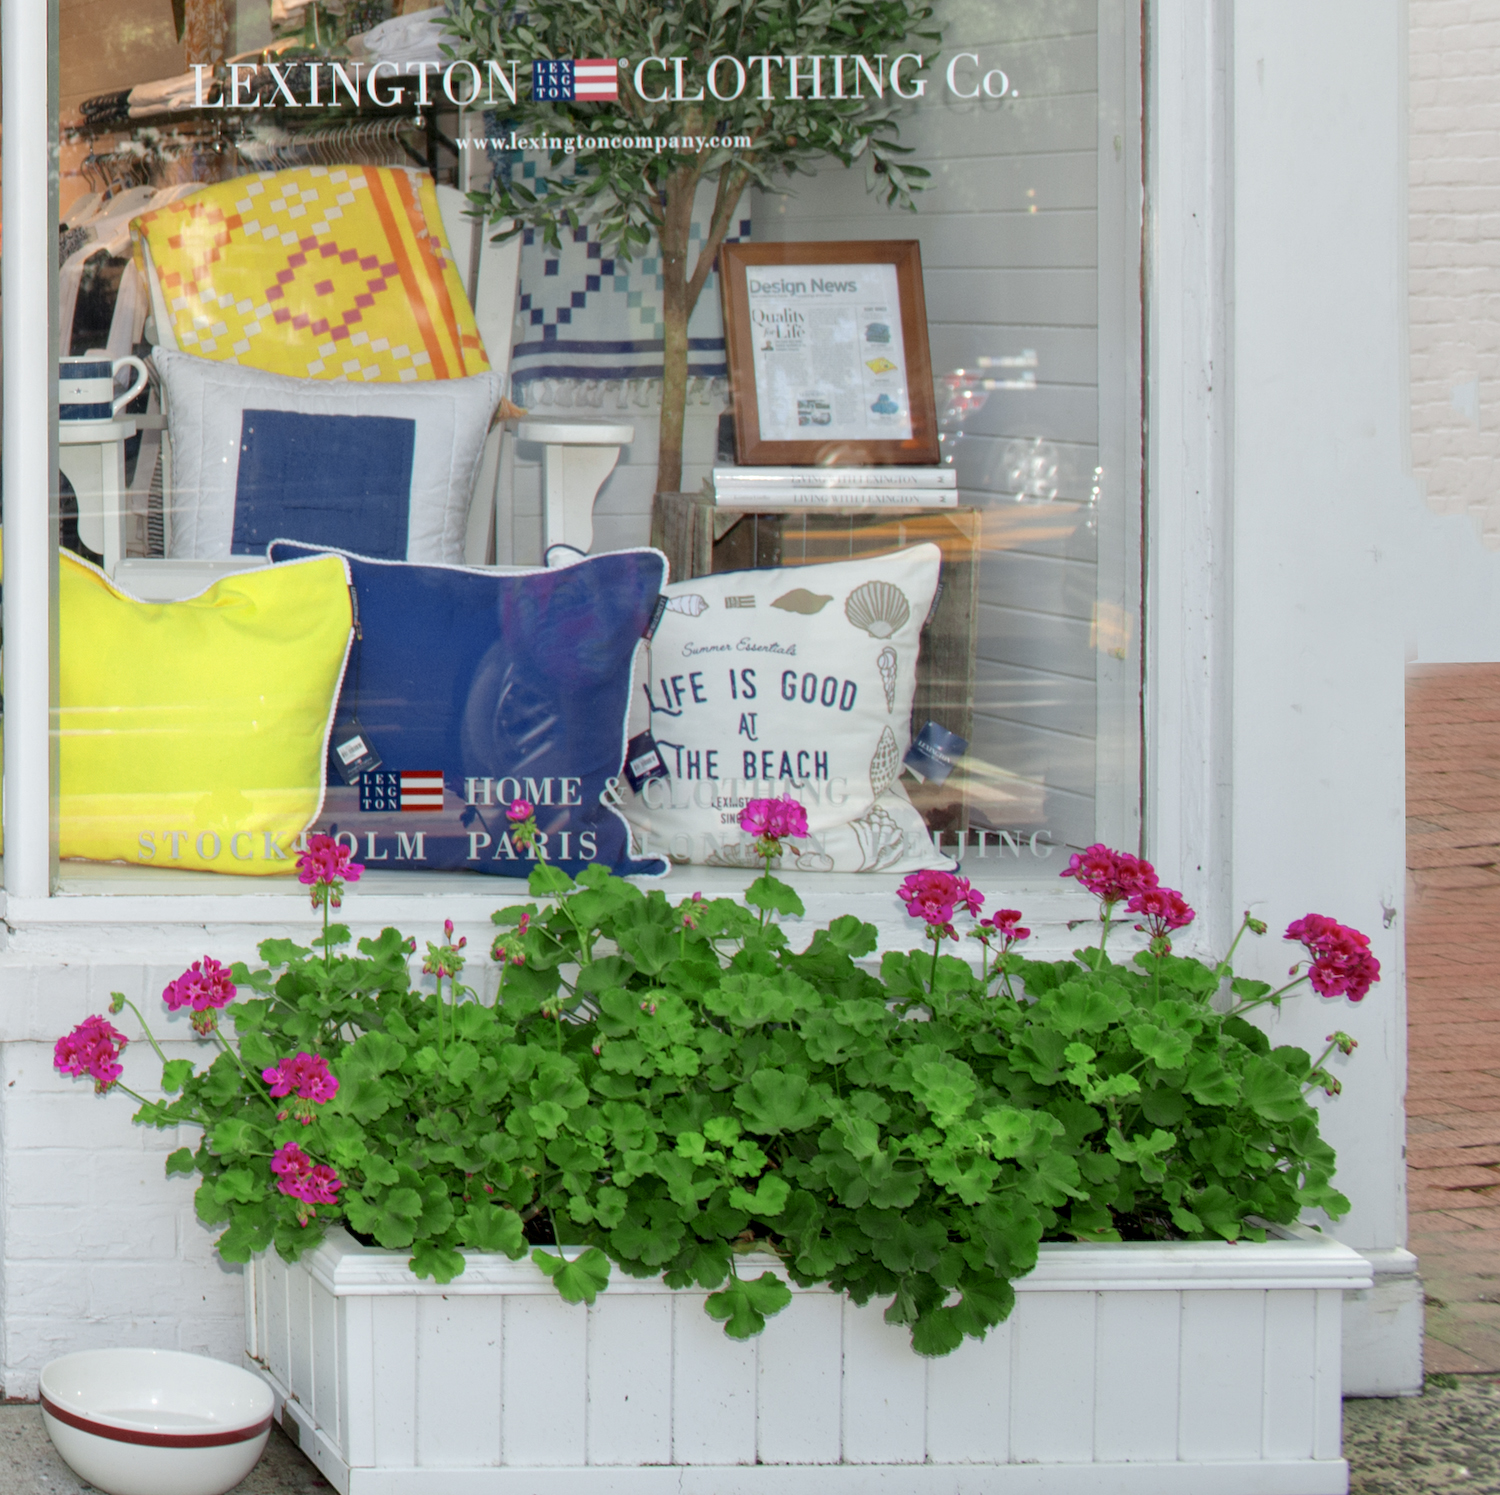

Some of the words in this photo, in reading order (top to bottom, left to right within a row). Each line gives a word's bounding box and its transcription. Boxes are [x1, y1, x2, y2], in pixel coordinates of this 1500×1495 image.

[537, 63, 571, 74] LEX
[634, 54, 927, 102] CLOTHING
[946, 53, 1019, 99] Co.
[189, 59, 521, 108] LEXINGTON
[538, 75, 571, 86] ING
[536, 87, 572, 99] TON
[456, 131, 752, 154] www.lexingtoncompany.com
[749, 279, 806, 295] Design
[811, 278, 857, 292] News
[752, 307, 805, 326] Quality
[776, 325, 806, 339] Life
[793, 494, 828, 503] LIVING
[860, 494, 920, 503] LEXINGTON
[682, 641, 732, 657] Summer
[736, 637, 797, 657] Essentials
[643, 672, 708, 716] LIFE
[730, 668, 757, 700] IS
[781, 670, 857, 711] GOOD
[739, 713, 758, 741] AT
[917, 739, 951, 764] LEXINGTON
[656, 740, 719, 780] THE
[743, 750, 828, 789] BEACH
[363, 774, 397, 785] LEX
[364, 786, 397, 797] ING
[465, 776, 582, 806] HOME
[599, 776, 627, 805] &
[642, 776, 850, 810] CLOTHING
[363, 798, 397, 810] TON
[466, 831, 598, 861] PARIS
[871, 830, 1054, 860] BEIJING
